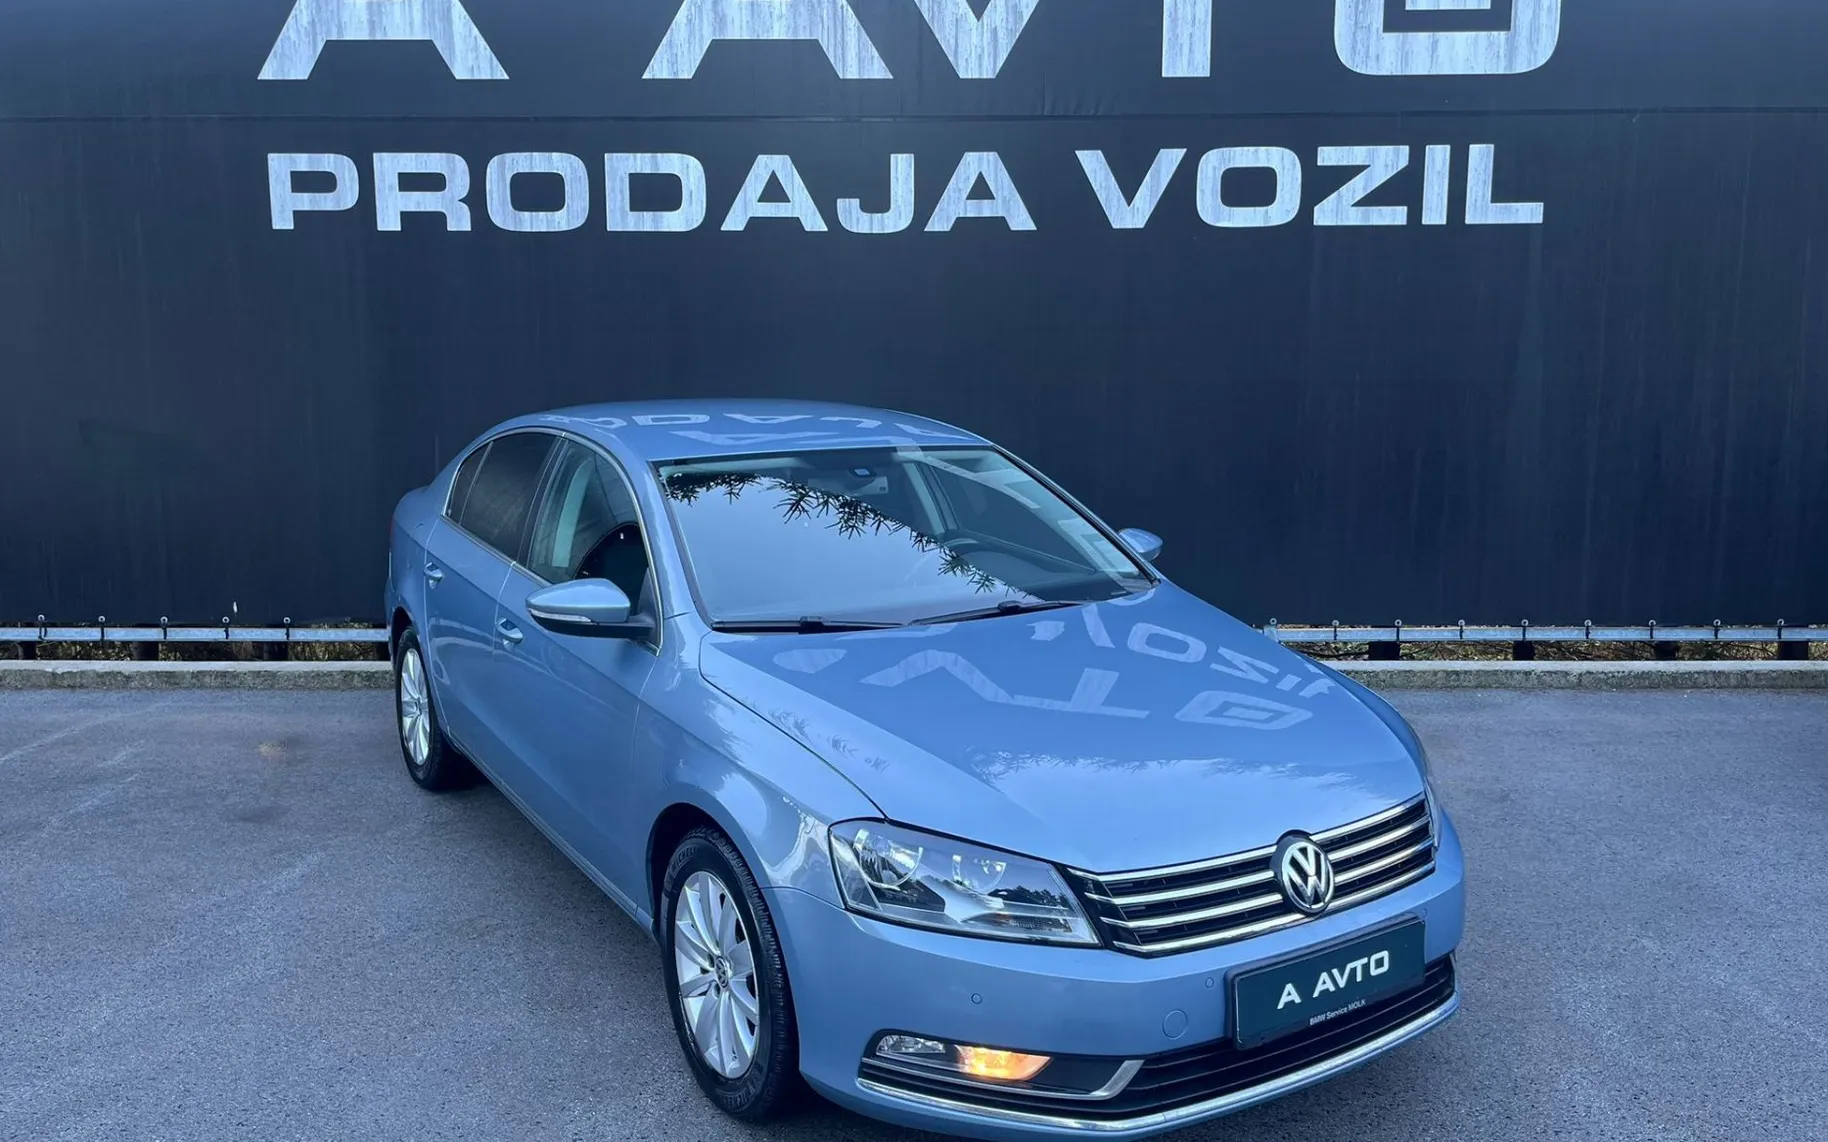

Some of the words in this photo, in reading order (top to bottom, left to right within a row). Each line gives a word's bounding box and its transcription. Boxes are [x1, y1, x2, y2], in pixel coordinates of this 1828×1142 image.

[267, 152, 1037, 234] PRODAJA
[1075, 144, 1544, 228] VOZIL
[1277, 983, 1302, 1010] A
[1312, 950, 1389, 998] AVTO
[1326, 1007, 1348, 1020] Service
